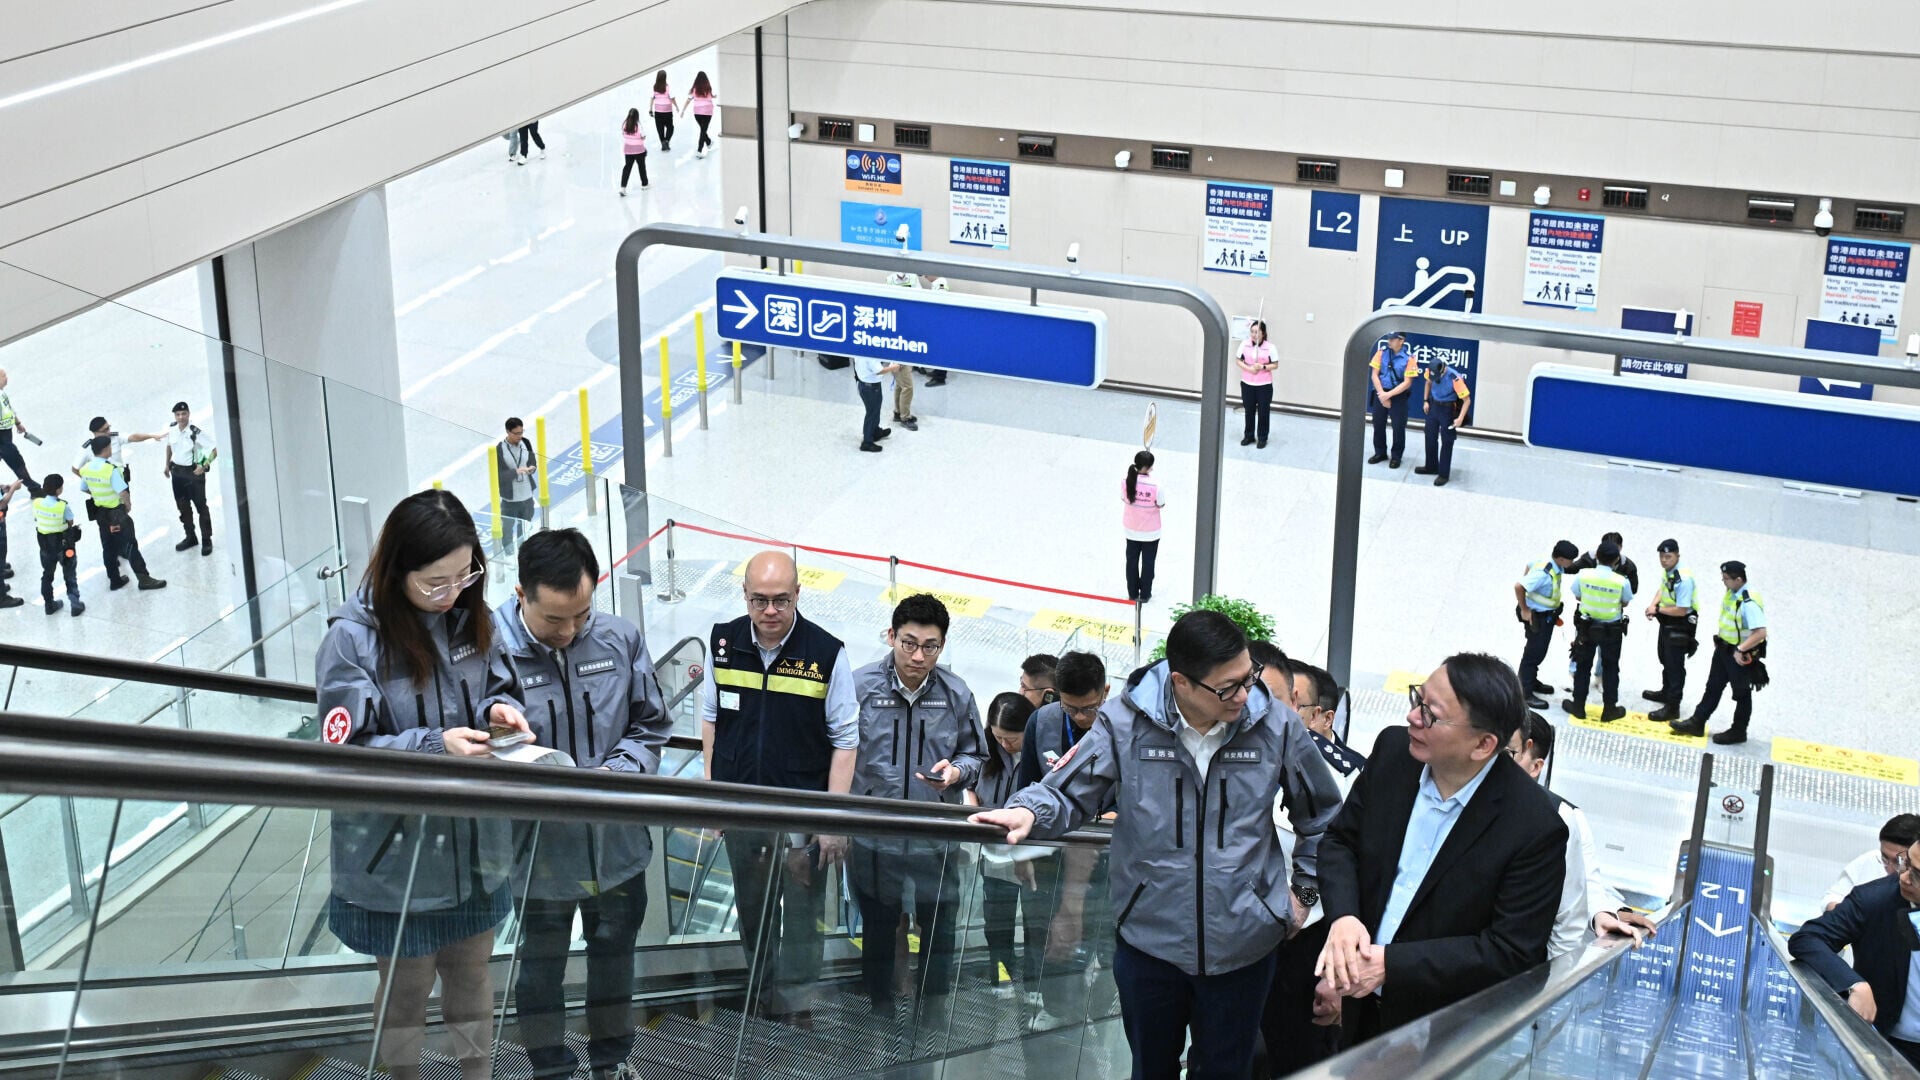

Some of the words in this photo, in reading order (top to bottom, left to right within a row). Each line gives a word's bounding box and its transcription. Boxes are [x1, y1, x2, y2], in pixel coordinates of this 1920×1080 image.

[1316, 209, 1352, 234] L2
[1393, 223, 1414, 243] 上
[1440, 229, 1470, 246] UP
[769, 301, 798, 331] 深
[853, 305, 897, 332] 深圳
[853, 331, 928, 353] Shenzhen
[1413, 344, 1469, 369] 往深圳
[1621, 358, 1684, 374] 請勿在此停留
[776, 667, 824, 680] IMMIGRATION
[779, 659, 819, 672] 入境處
[1701, 881, 1745, 904] L2
[1692, 951, 1736, 967] ZHEN
[1691, 965, 1734, 980] SHEN
